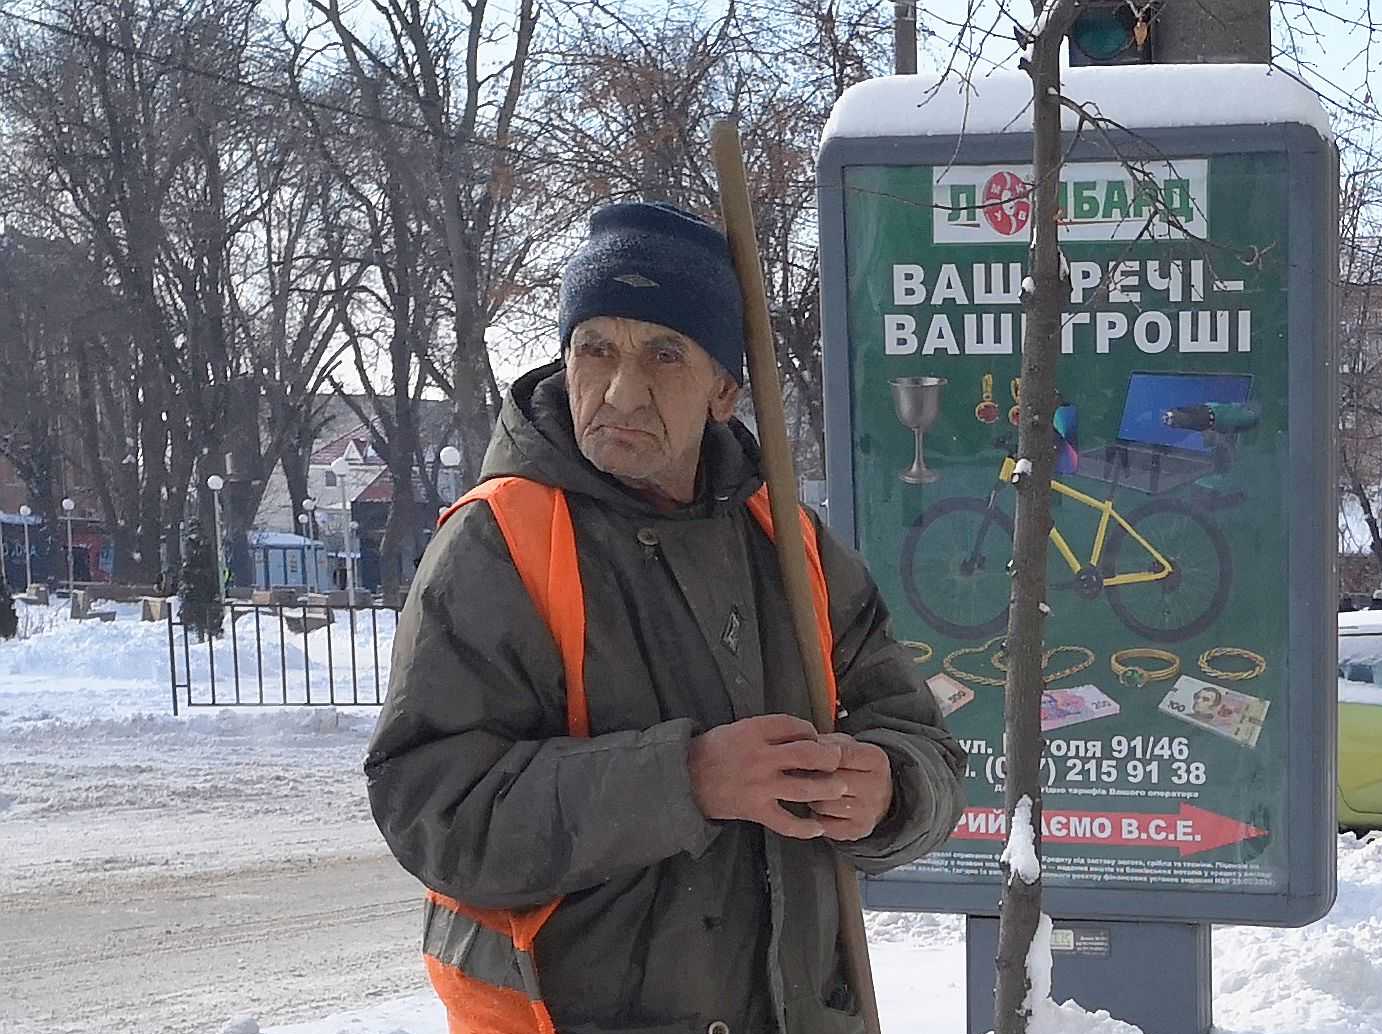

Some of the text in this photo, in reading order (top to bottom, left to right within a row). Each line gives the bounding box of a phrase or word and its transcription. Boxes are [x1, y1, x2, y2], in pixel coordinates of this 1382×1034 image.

[892, 262, 1024, 306] ВАШ
[1060, 310, 1252, 354] ГРОШІ
[958, 738, 994, 755] ул.
[1111, 735, 1190, 760] 91/46
[1065, 757, 1119, 783] 215
[1126, 759, 1160, 784] 91
[1170, 761, 1208, 786] 38
[1121, 816, 1202, 843] В.С.Е.
